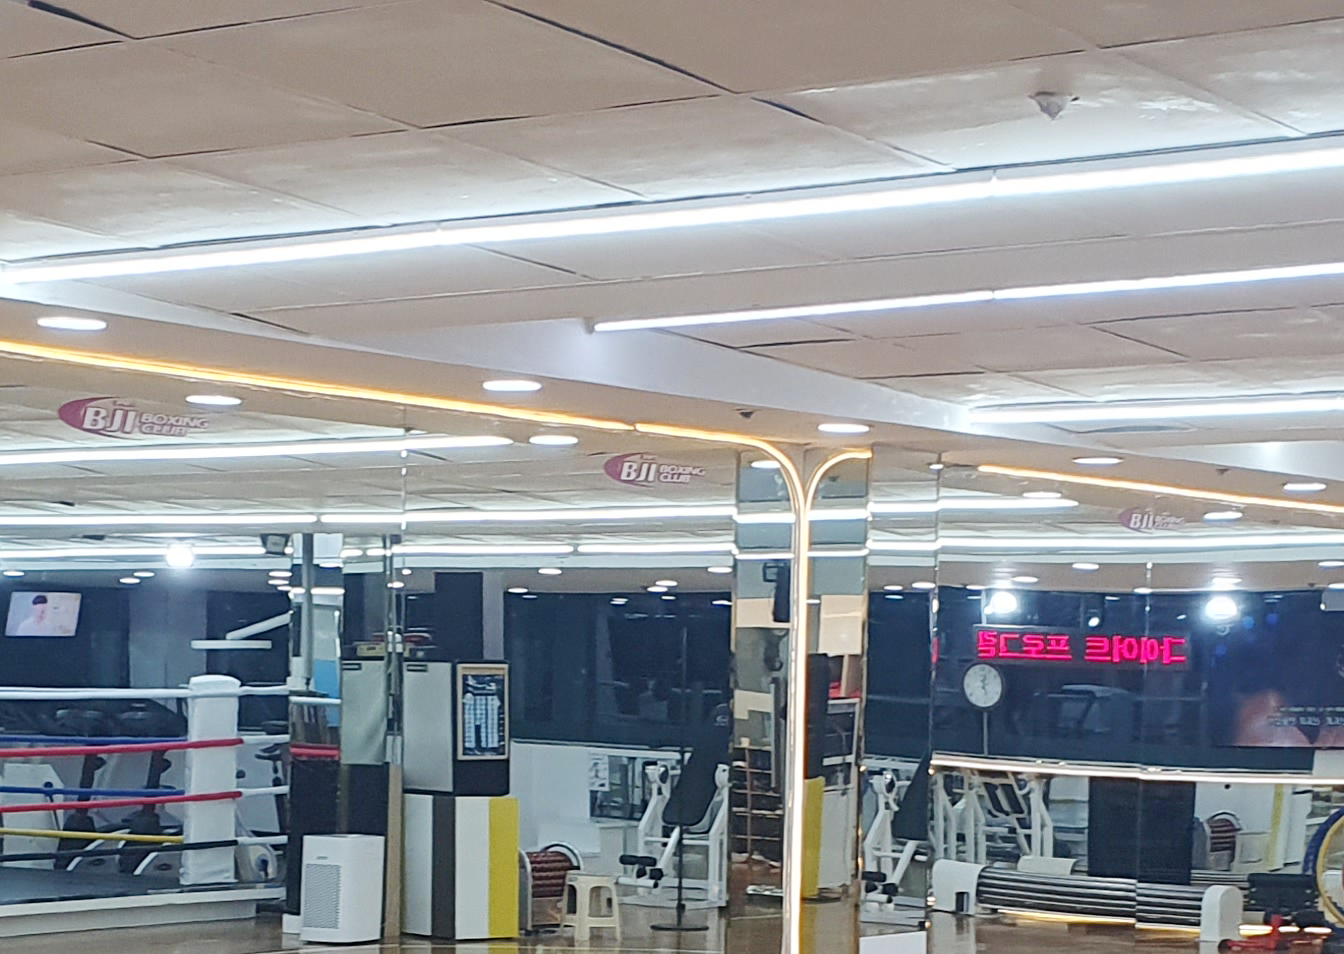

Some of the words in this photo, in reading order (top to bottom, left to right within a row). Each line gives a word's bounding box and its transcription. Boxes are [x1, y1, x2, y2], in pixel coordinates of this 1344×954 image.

[82, 406, 139, 434] BJI
[140, 413, 210, 430] BOXING
[139, 423, 188, 437] CLUB
[620, 460, 658, 482] BJI
[659, 464, 706, 476] BOXING
[1129, 513, 1155, 529] BJI
